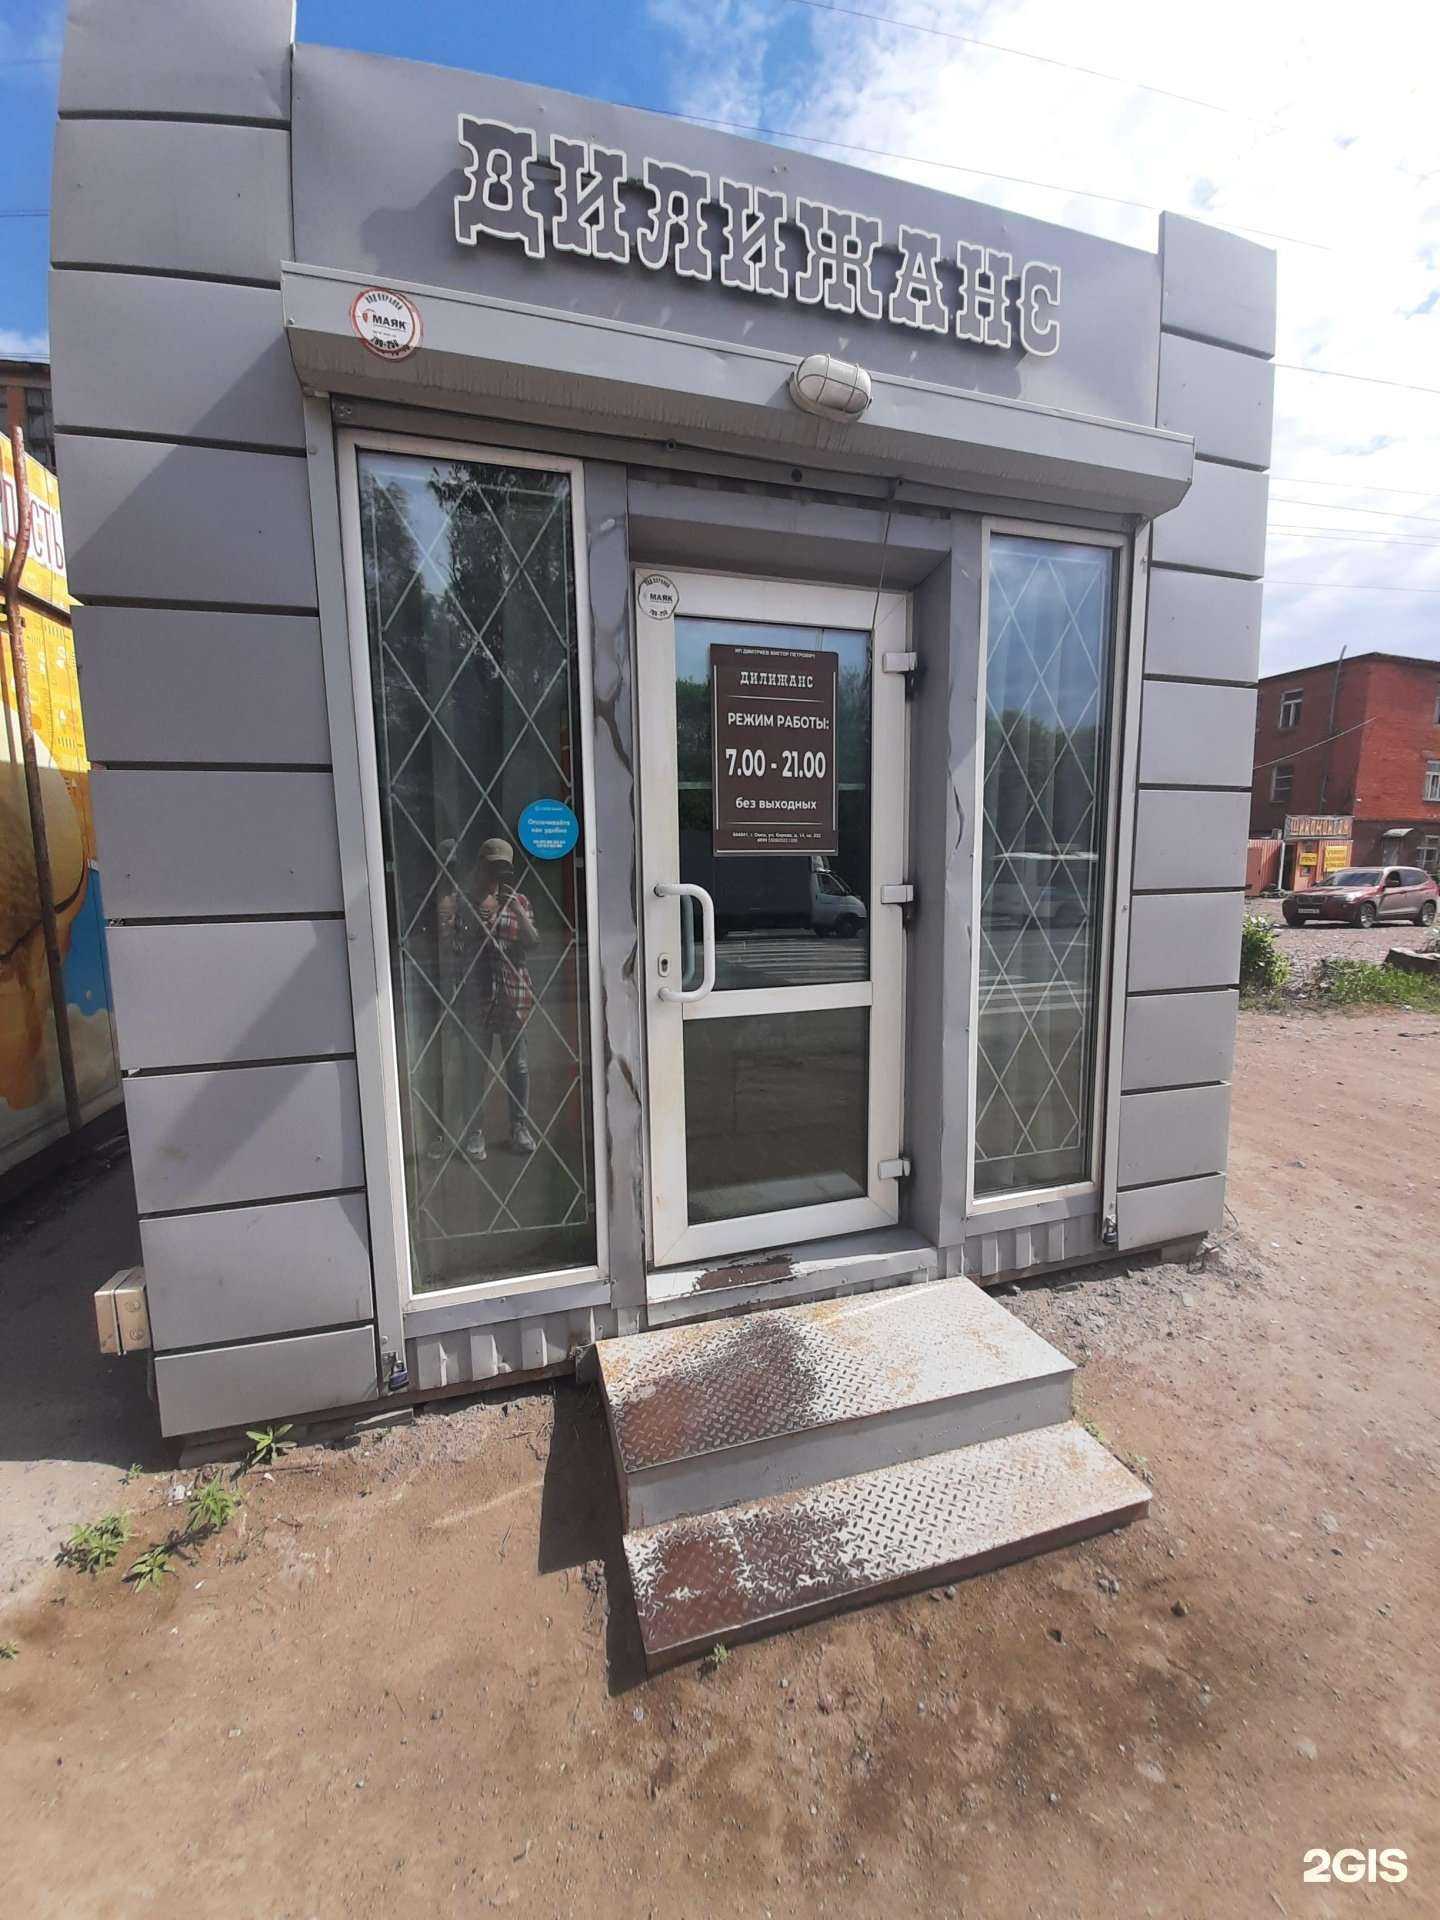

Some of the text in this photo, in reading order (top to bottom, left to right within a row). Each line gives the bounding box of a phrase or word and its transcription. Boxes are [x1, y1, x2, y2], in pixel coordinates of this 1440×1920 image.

[453, 113, 1062, 357] ДИЛИЖАНС
[372, 314, 406, 330] МАЯК
[649, 592, 673, 602] МАЯК
[740, 671, 814, 688] ДИЛИЖАНС
[727, 712, 830, 730] РЕЖИМ РАБОТЫ:
[725, 748, 766, 777] 7.00
[782, 750, 826, 779] 21.00
[735, 796, 817, 810] без выходных
